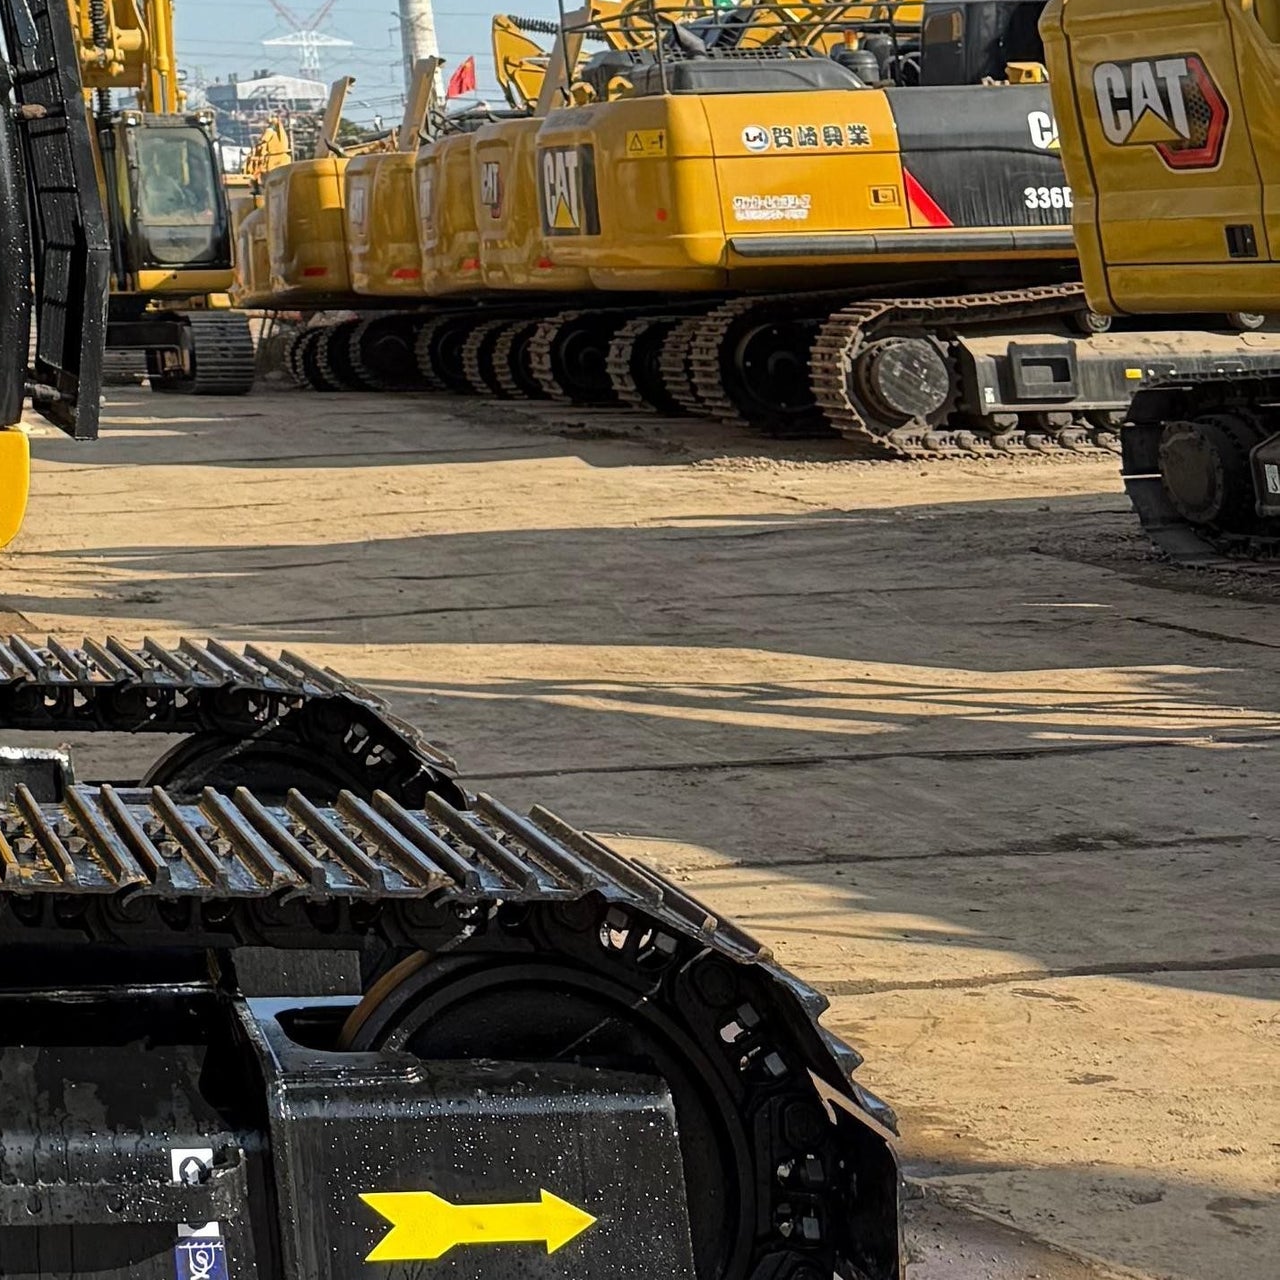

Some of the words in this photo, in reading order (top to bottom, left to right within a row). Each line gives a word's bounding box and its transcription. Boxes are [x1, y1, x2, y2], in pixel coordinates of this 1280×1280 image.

[1027, 110, 1060, 149] C
[1093, 58, 1189, 144] CAT
[543, 150, 581, 229] CAT
